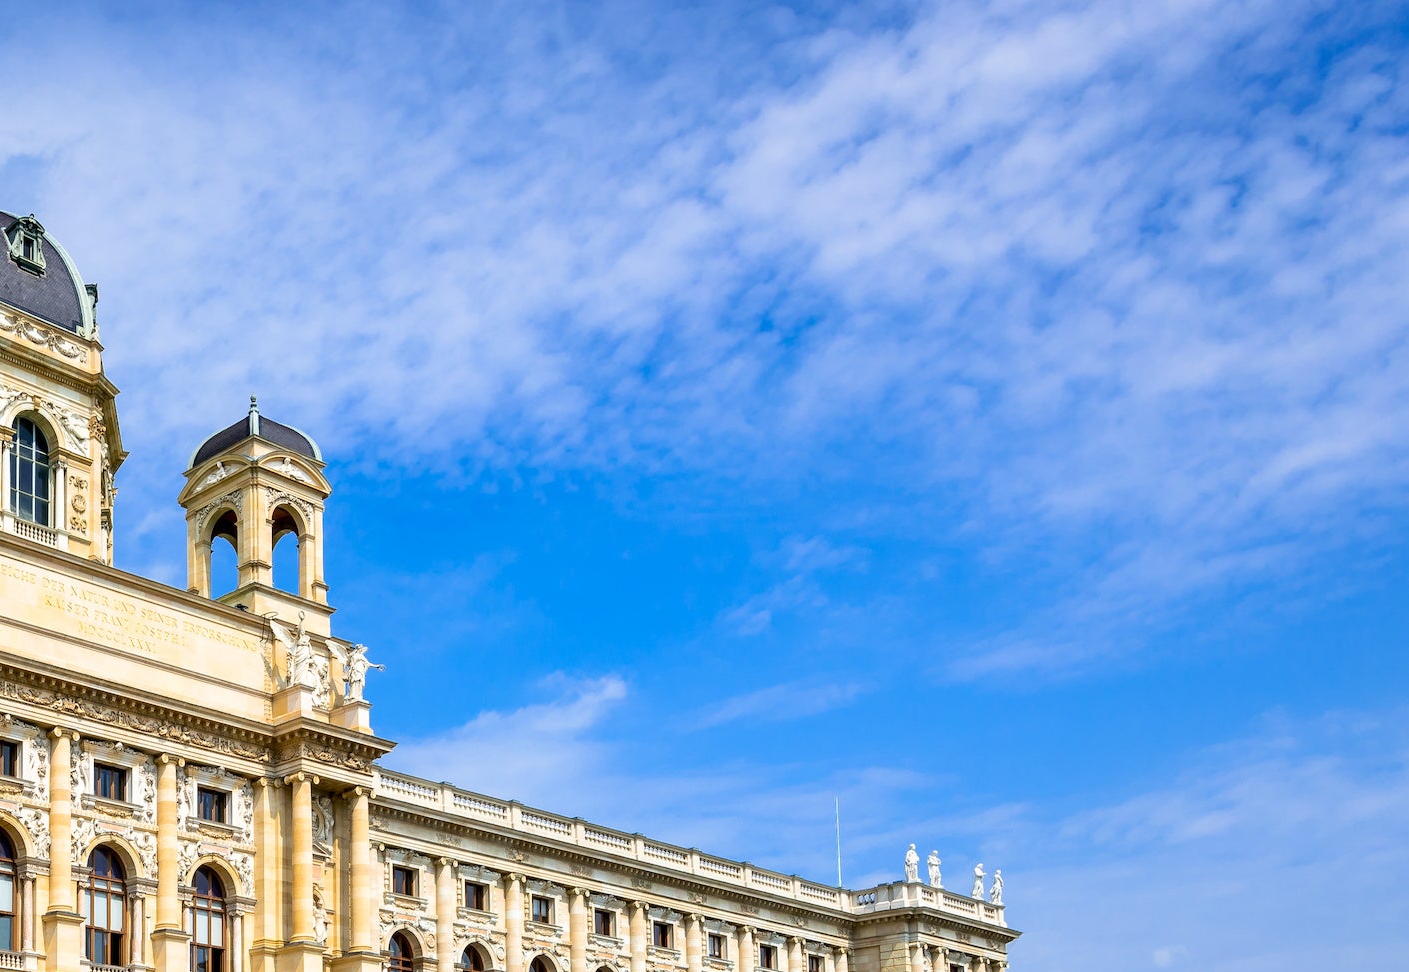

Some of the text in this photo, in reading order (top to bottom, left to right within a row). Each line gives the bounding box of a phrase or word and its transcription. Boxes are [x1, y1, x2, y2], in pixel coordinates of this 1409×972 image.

[41, 576, 66, 593] DER
[70, 584, 110, 608] NATUR
[113, 598, 137, 616] UND
[141, 608, 178, 629] SEINER
[182, 620, 259, 653] ERFORSCHUNG
[44, 594, 89, 618] KAISER
[93, 609, 130, 632] FRANZ
[134, 621, 180, 645] JOSEPH
